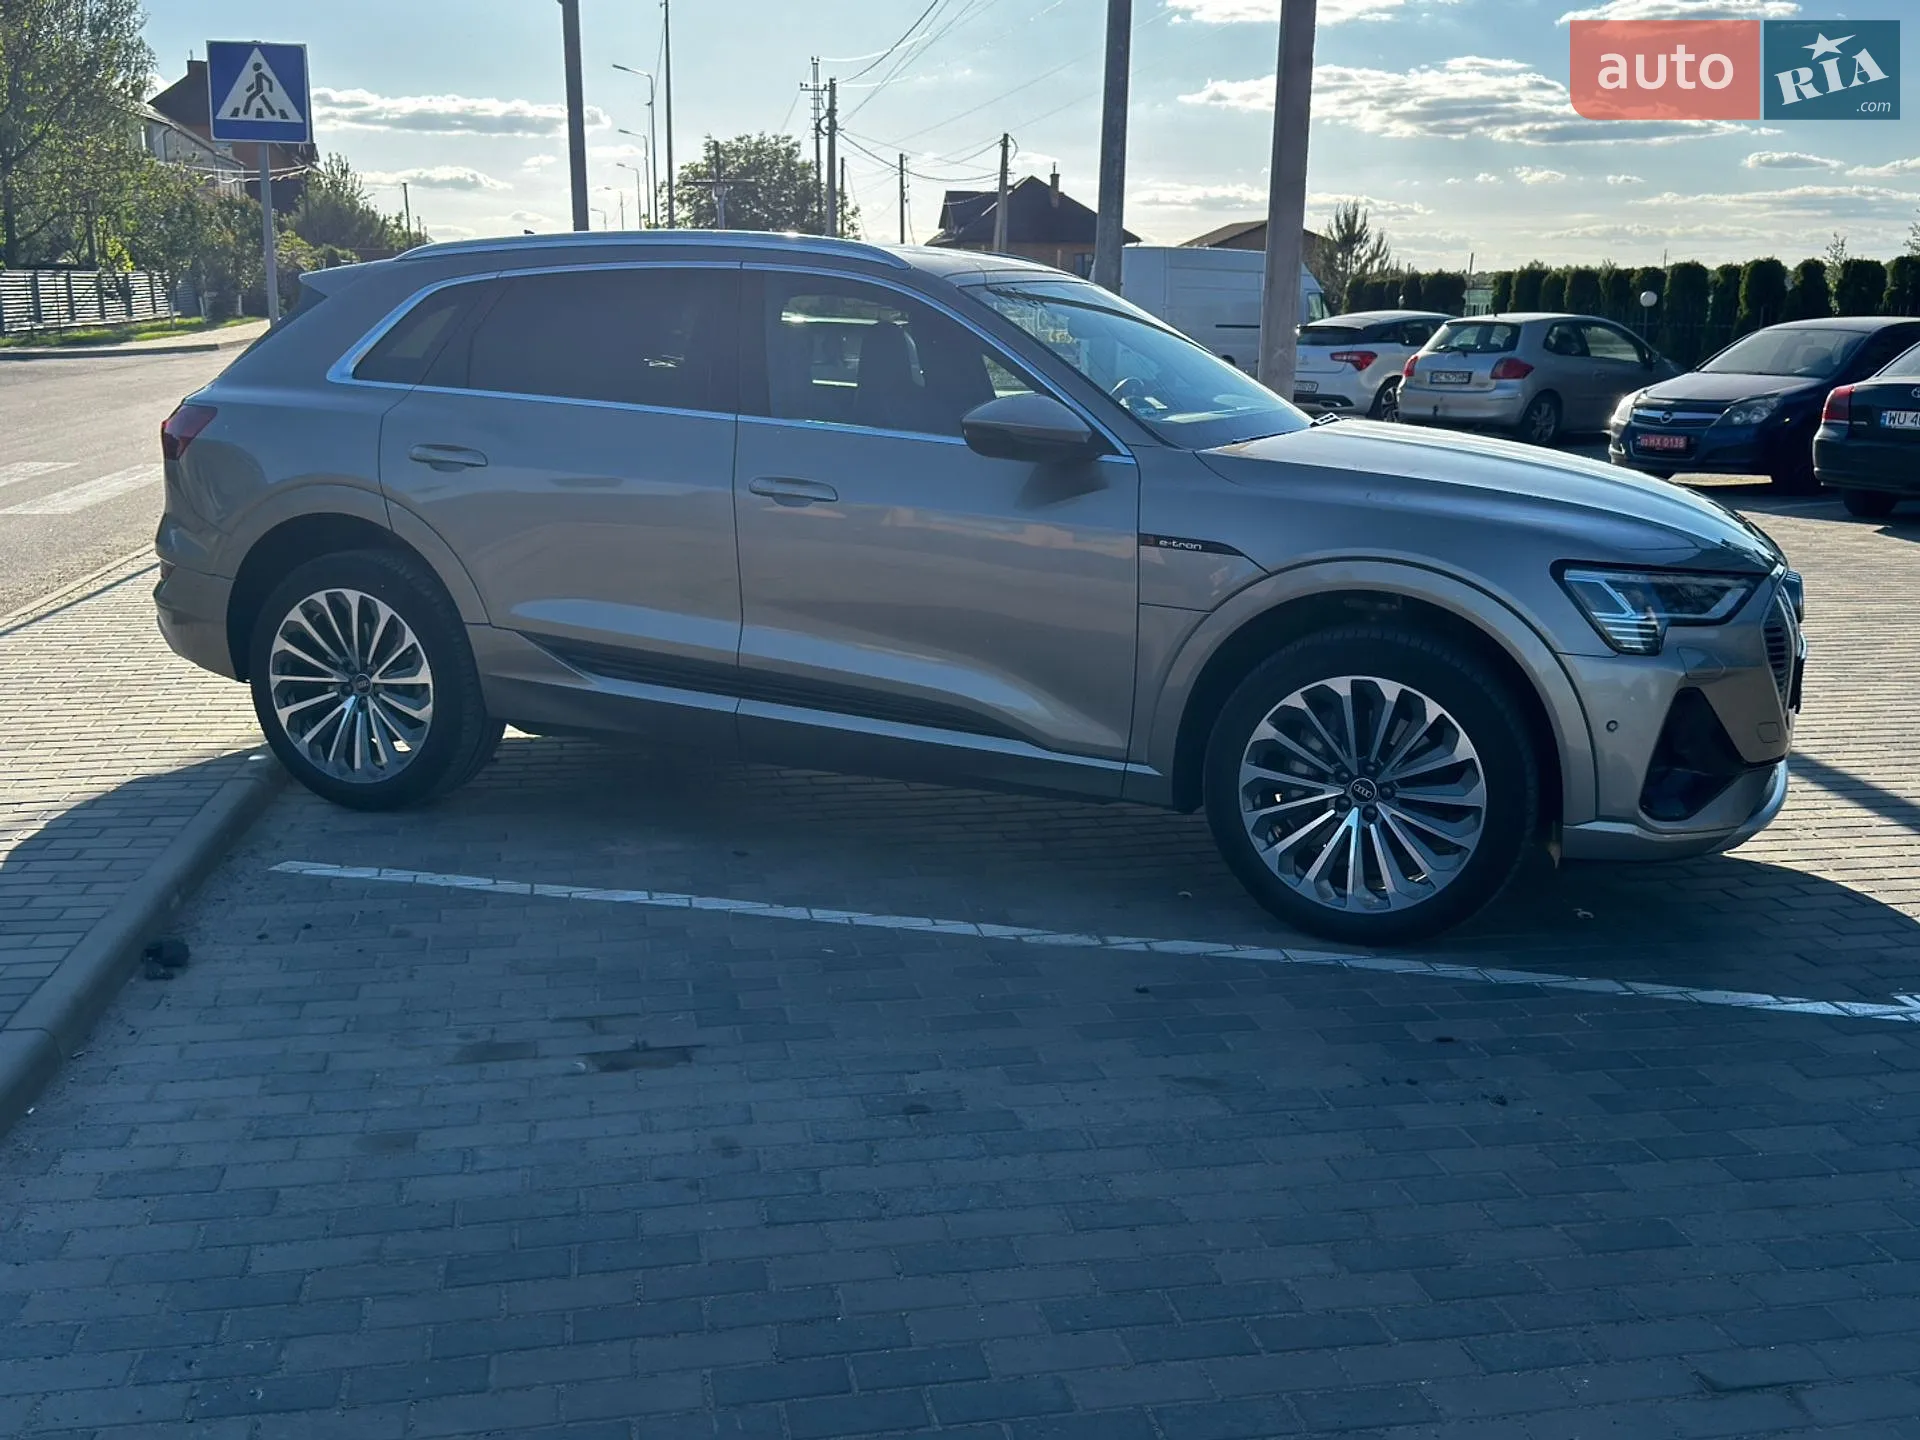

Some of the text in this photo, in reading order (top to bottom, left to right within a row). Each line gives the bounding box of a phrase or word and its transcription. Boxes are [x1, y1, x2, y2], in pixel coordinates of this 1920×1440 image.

[1888, 412, 1920, 426] WU 4
[1159, 540, 1202, 550] e-tron
